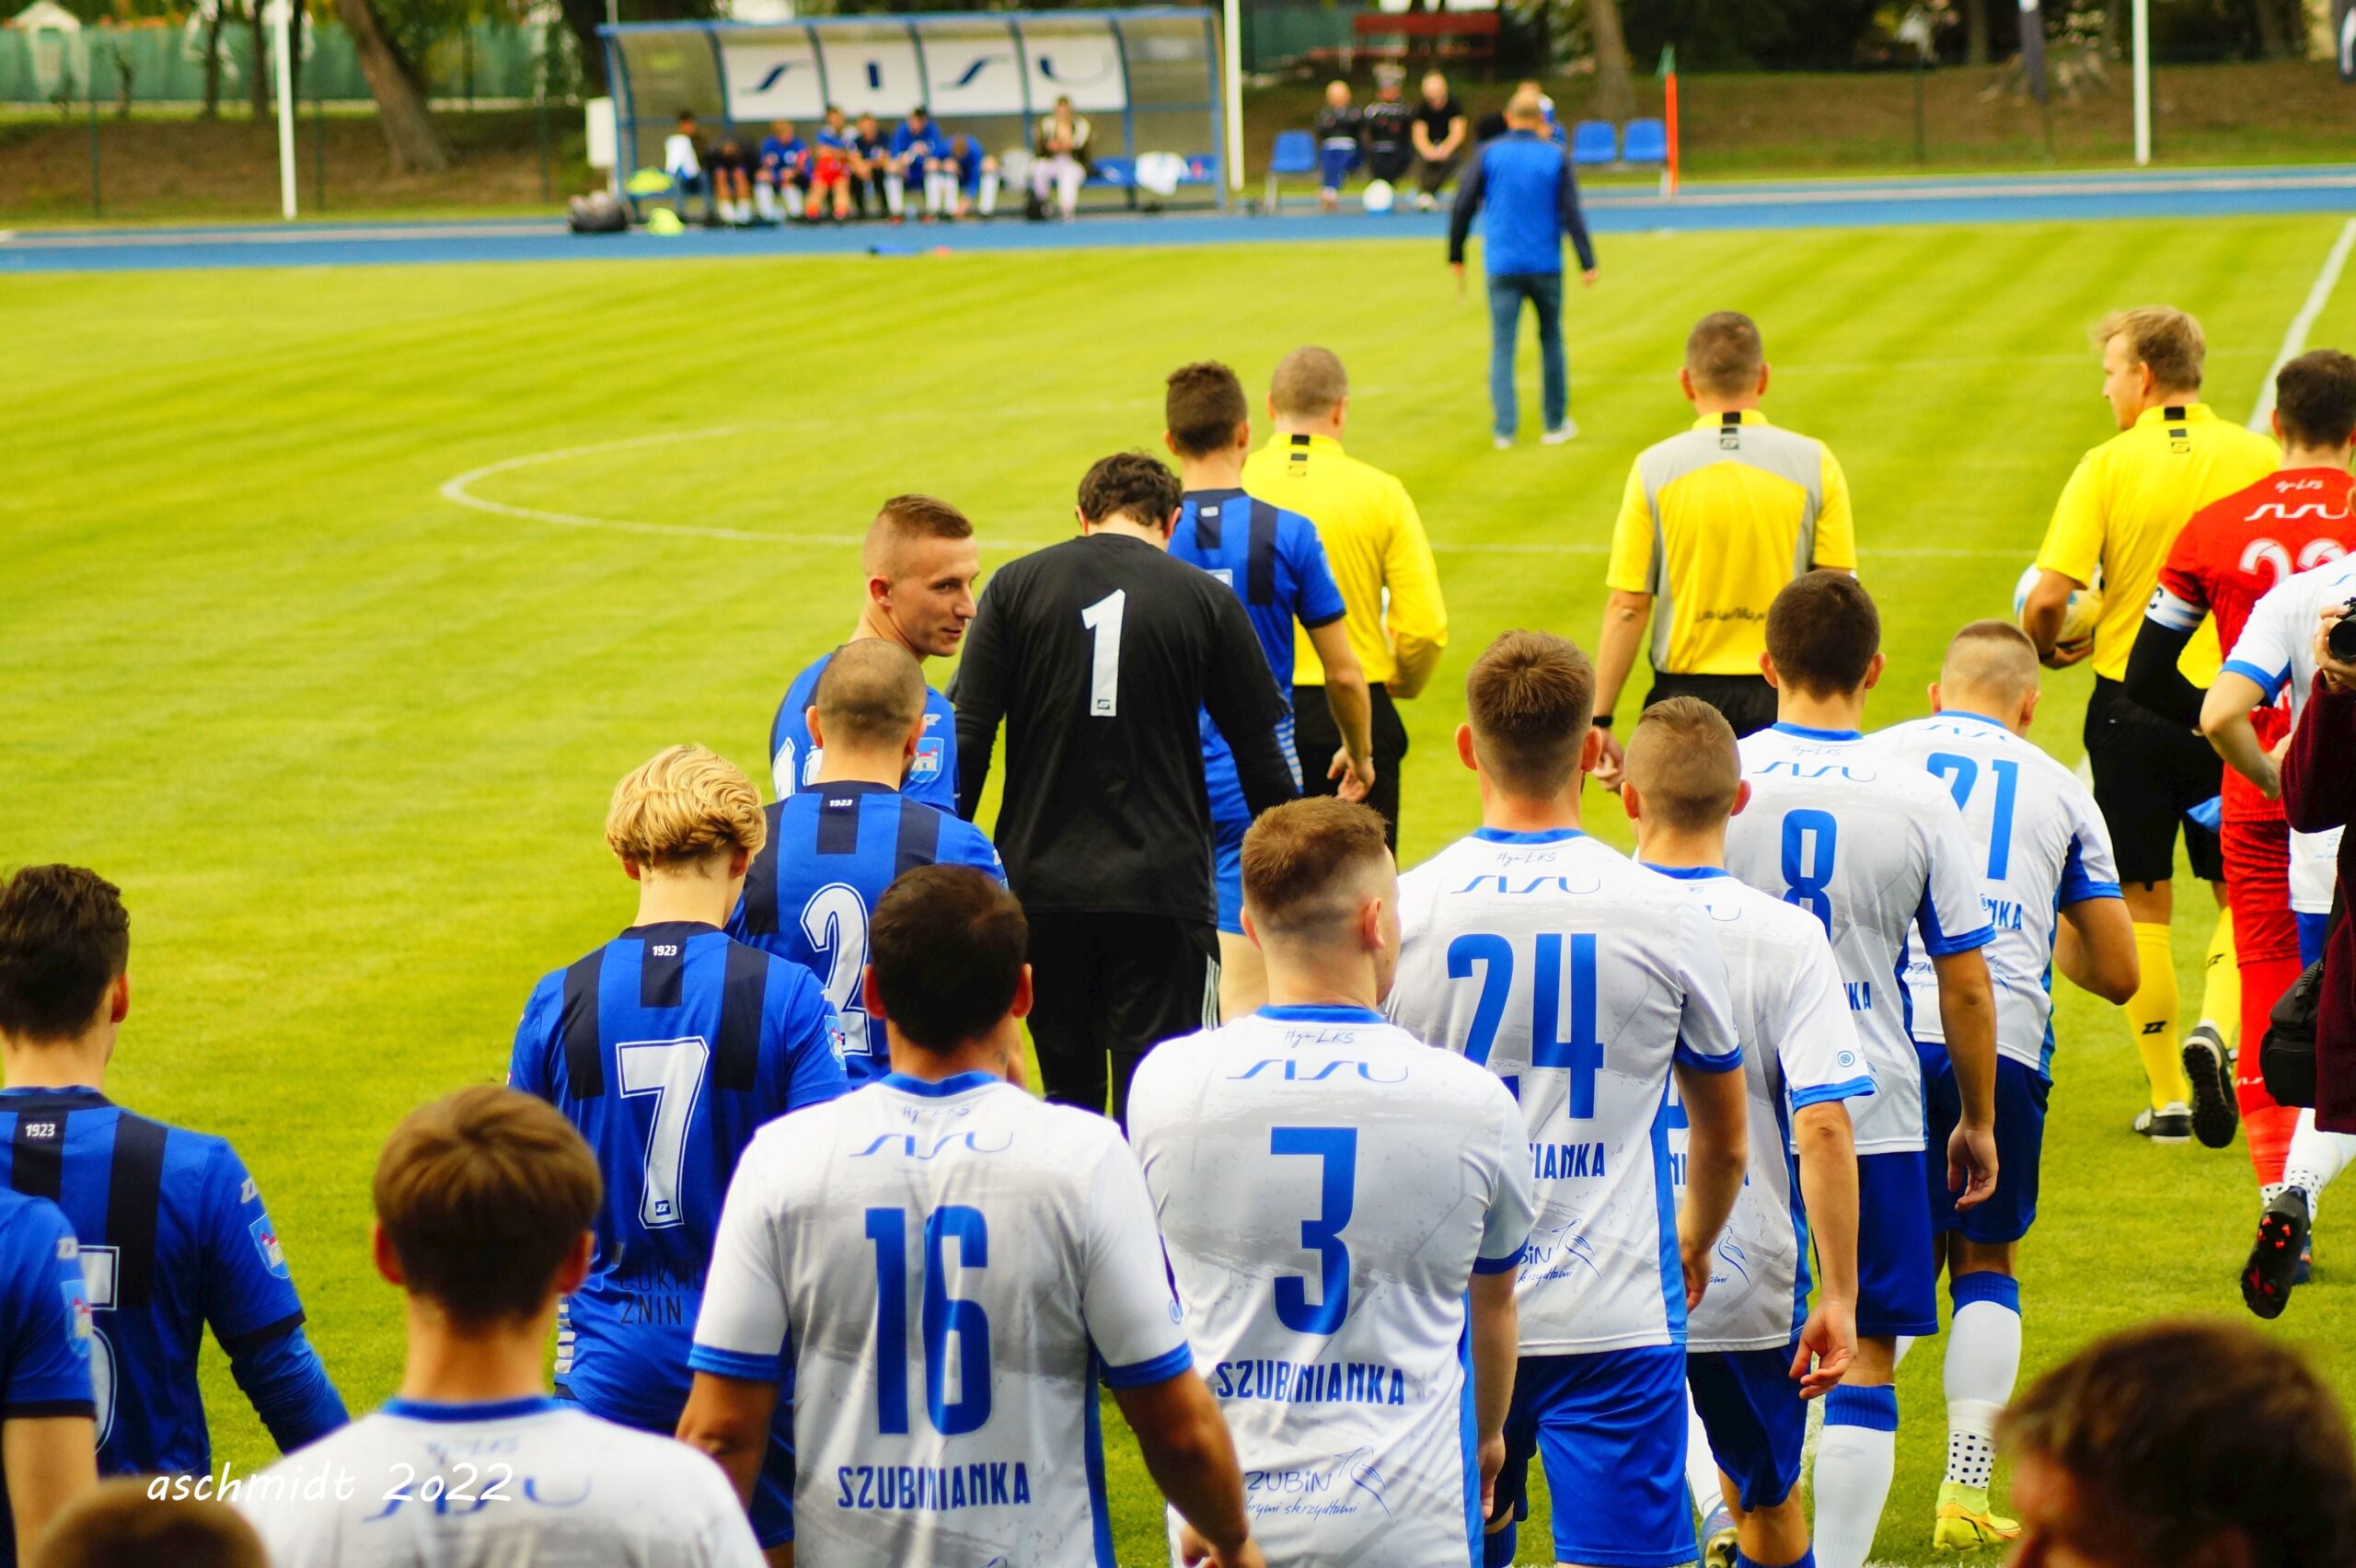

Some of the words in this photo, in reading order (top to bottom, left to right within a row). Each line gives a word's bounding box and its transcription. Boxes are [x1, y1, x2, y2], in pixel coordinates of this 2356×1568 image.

[1081, 589, 1126, 717] 1
[1782, 809, 1837, 943] 8
[653, 945, 677, 956] 1923
[800, 882, 872, 1056] 2
[1448, 933, 1604, 1119] 24
[25, 1124, 56, 1138] 1923
[616, 1036, 710, 1229] 7
[1530, 1142, 1605, 1180] IANKA
[1270, 1126, 1357, 1335] 3
[865, 1205, 992, 1435] 16
[1215, 1359, 1404, 1406] SZUBINIANKA
[1245, 1470, 1332, 1493] ZUBiN
